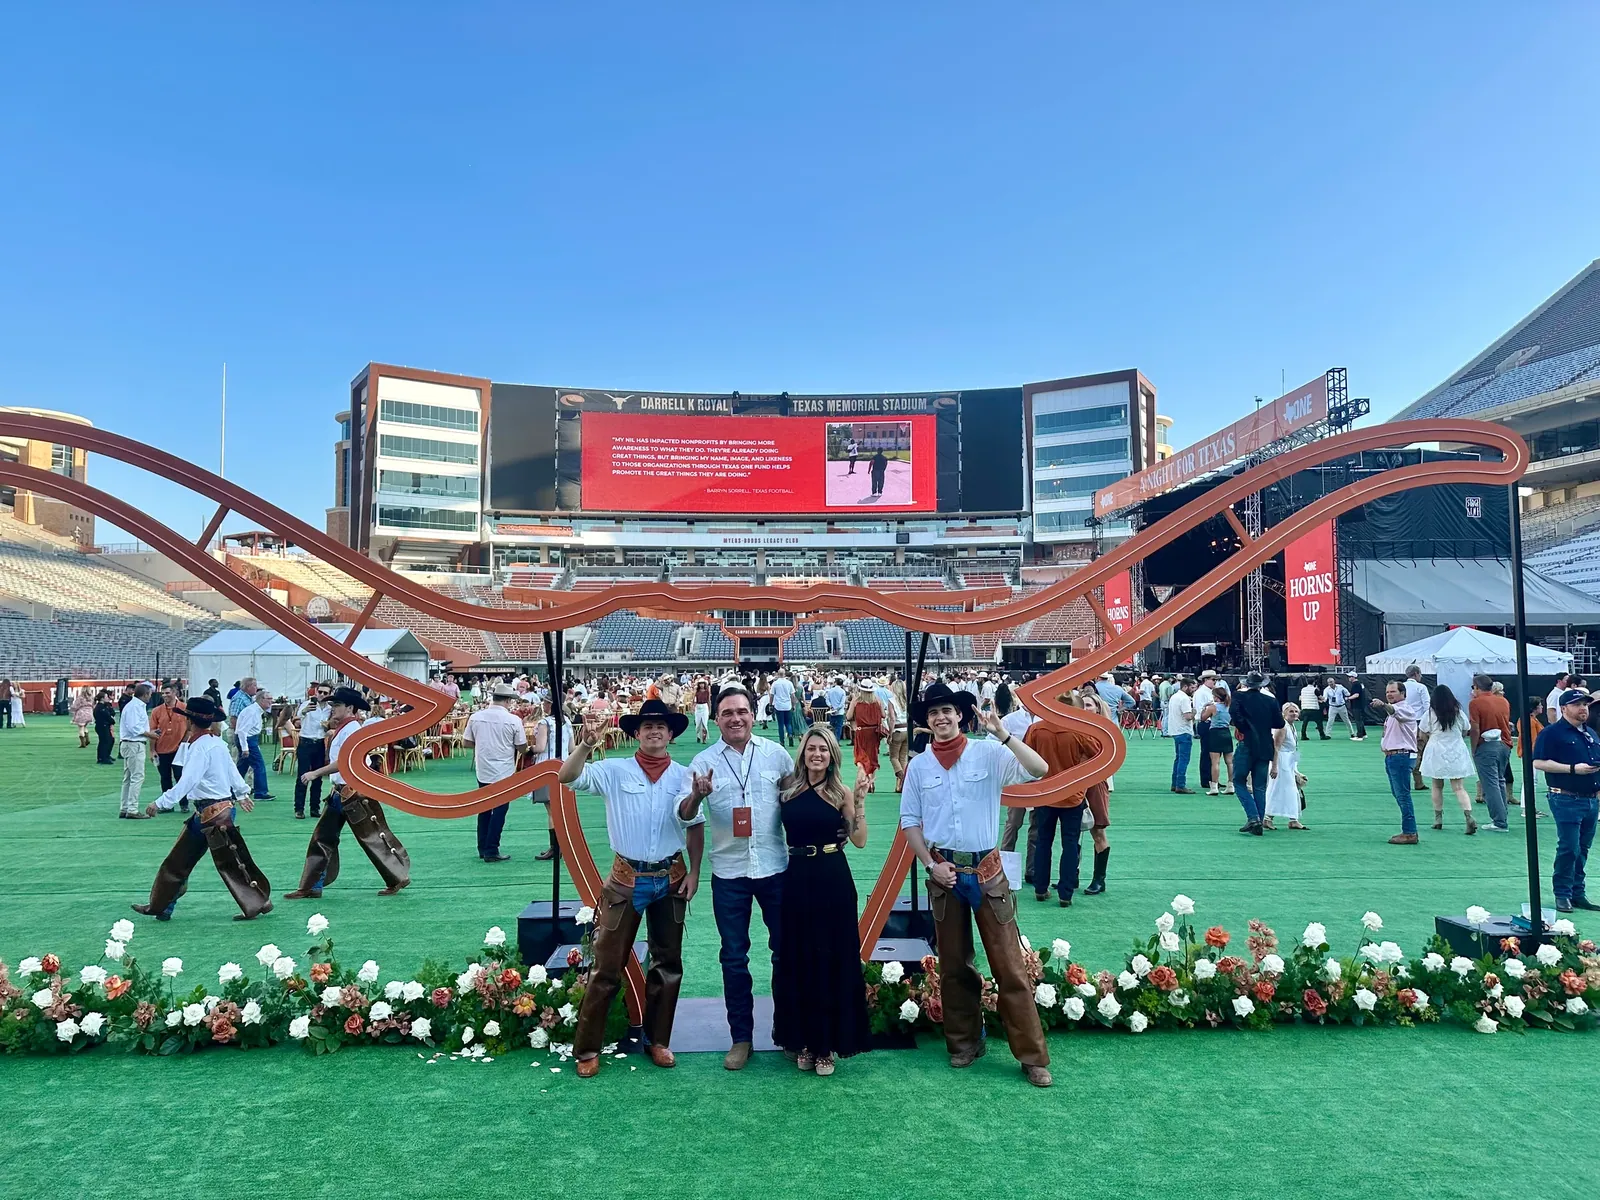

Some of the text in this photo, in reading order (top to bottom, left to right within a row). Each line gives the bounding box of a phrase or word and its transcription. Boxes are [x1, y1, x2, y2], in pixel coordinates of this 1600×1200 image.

[640, 397, 729, 411] DARRELL K ROYAL
[793, 397, 927, 412] TEXAS MEMORIAL STADIUM
[1139, 432, 1235, 494] A NIGHT FOR TEXAS
[1290, 573, 1333, 598] HORNS
[1107, 605, 1129, 621] HORNS
[1302, 601, 1320, 622] UP
